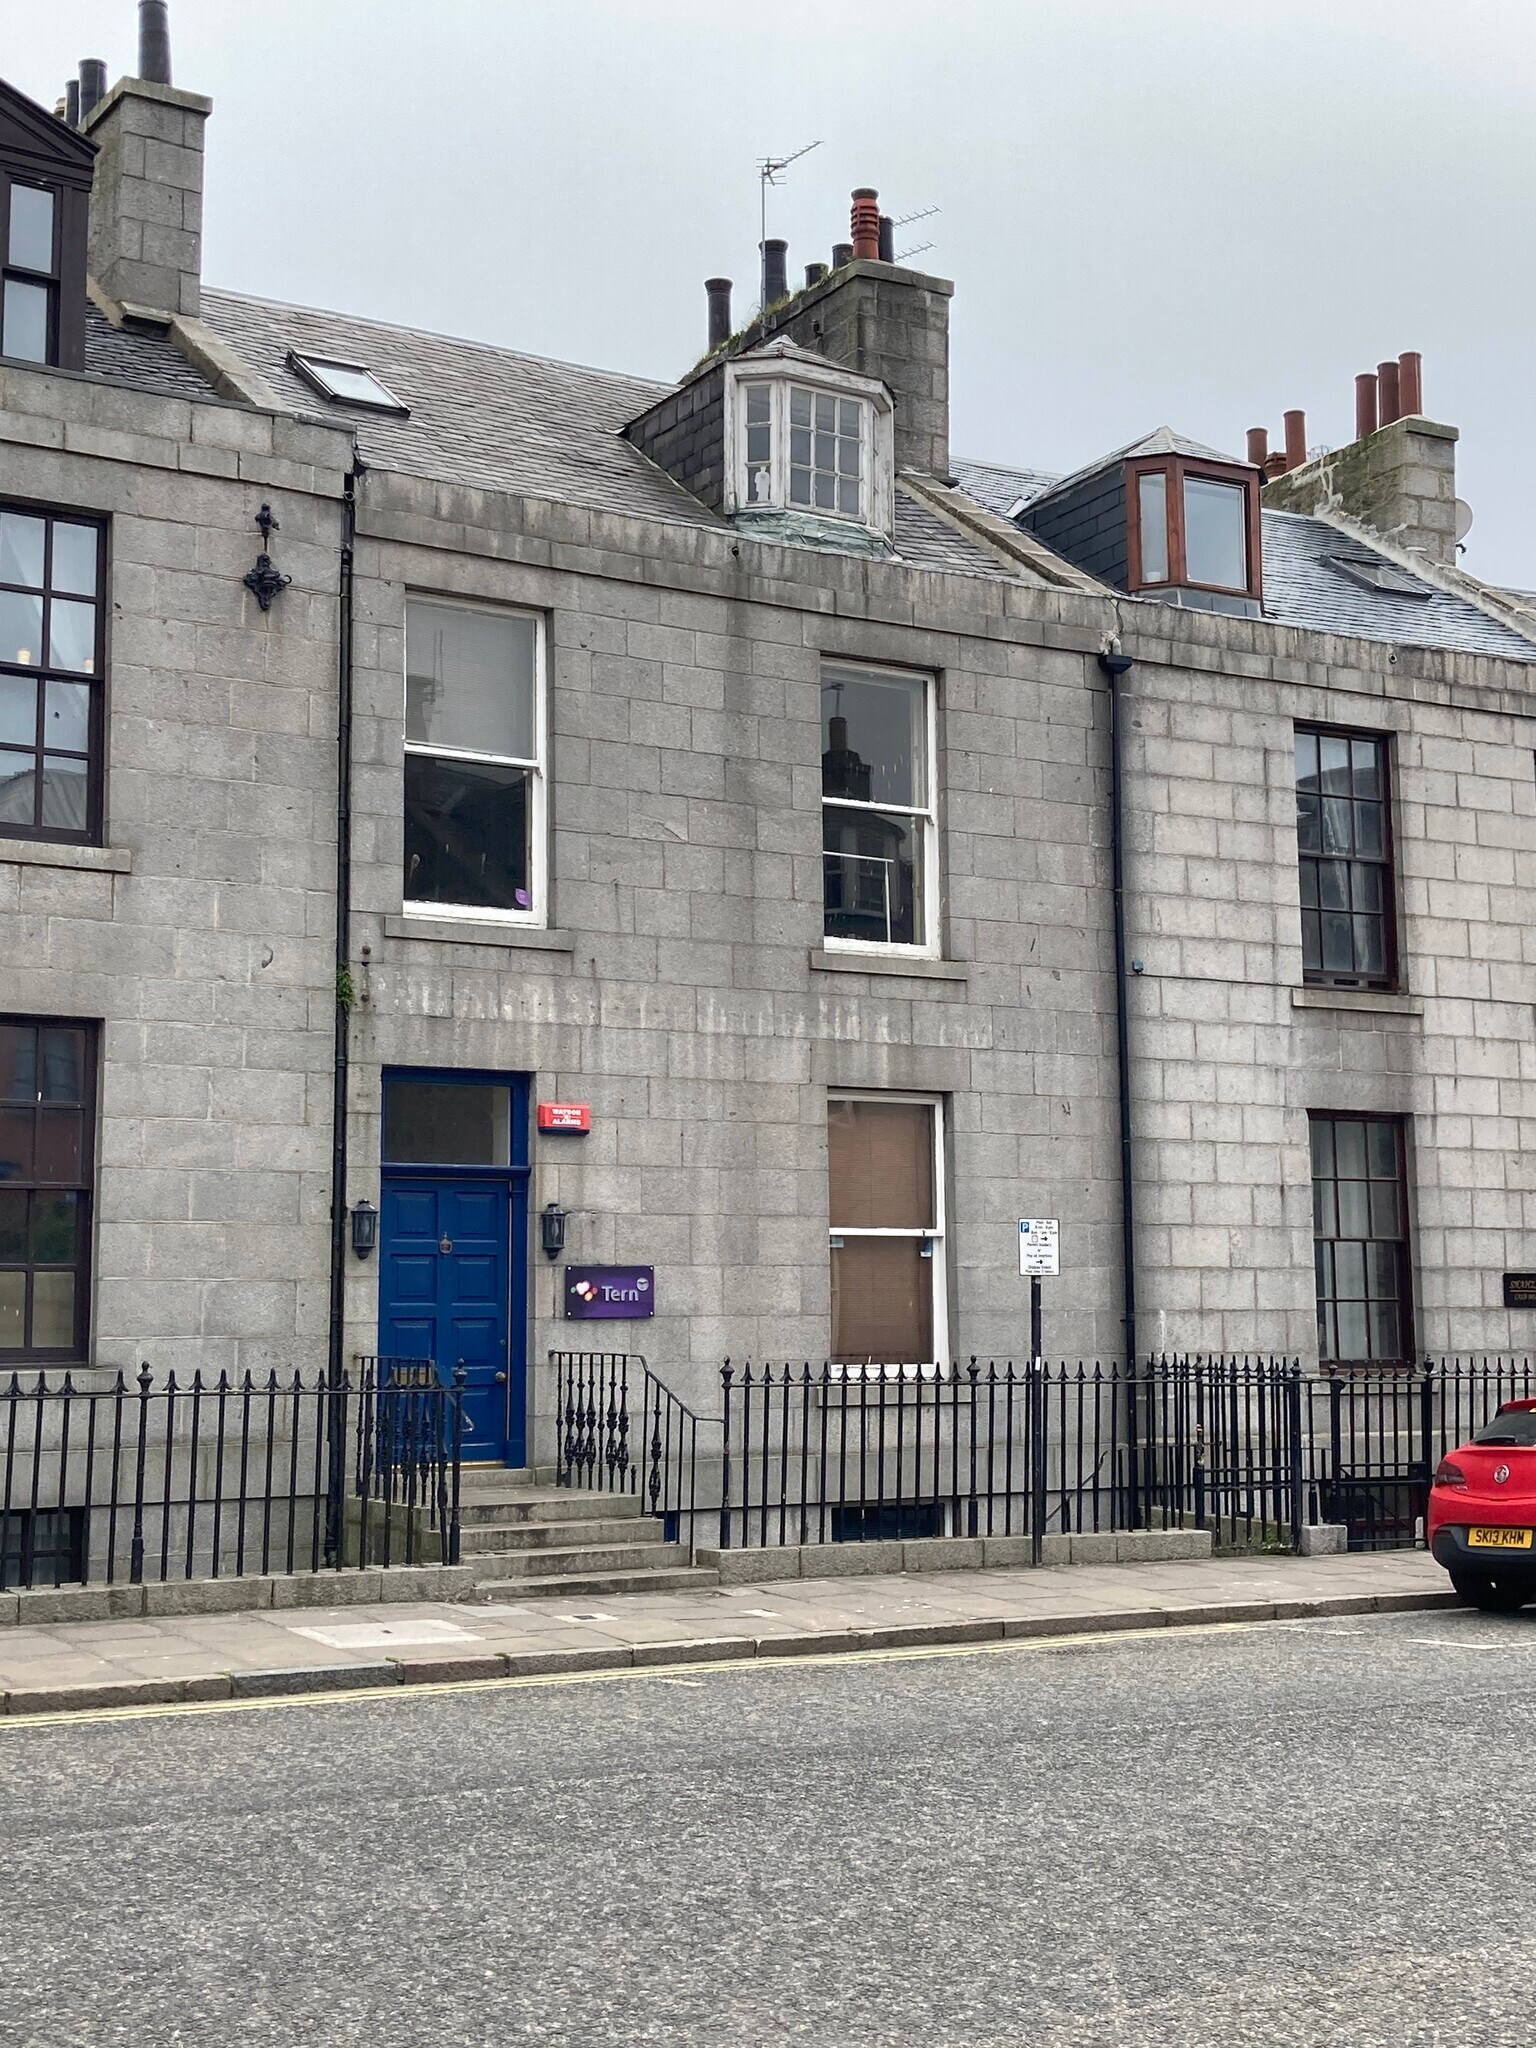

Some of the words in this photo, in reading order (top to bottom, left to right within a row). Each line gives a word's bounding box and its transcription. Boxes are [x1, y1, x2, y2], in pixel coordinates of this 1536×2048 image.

[552, 1118, 582, 1126] ALARMS
[1022, 1222, 1029, 1232] P
[601, 1285, 639, 1302] Tern
[1475, 1529, 1500, 1543] SK13
[1502, 1530, 1525, 1545] KHM
